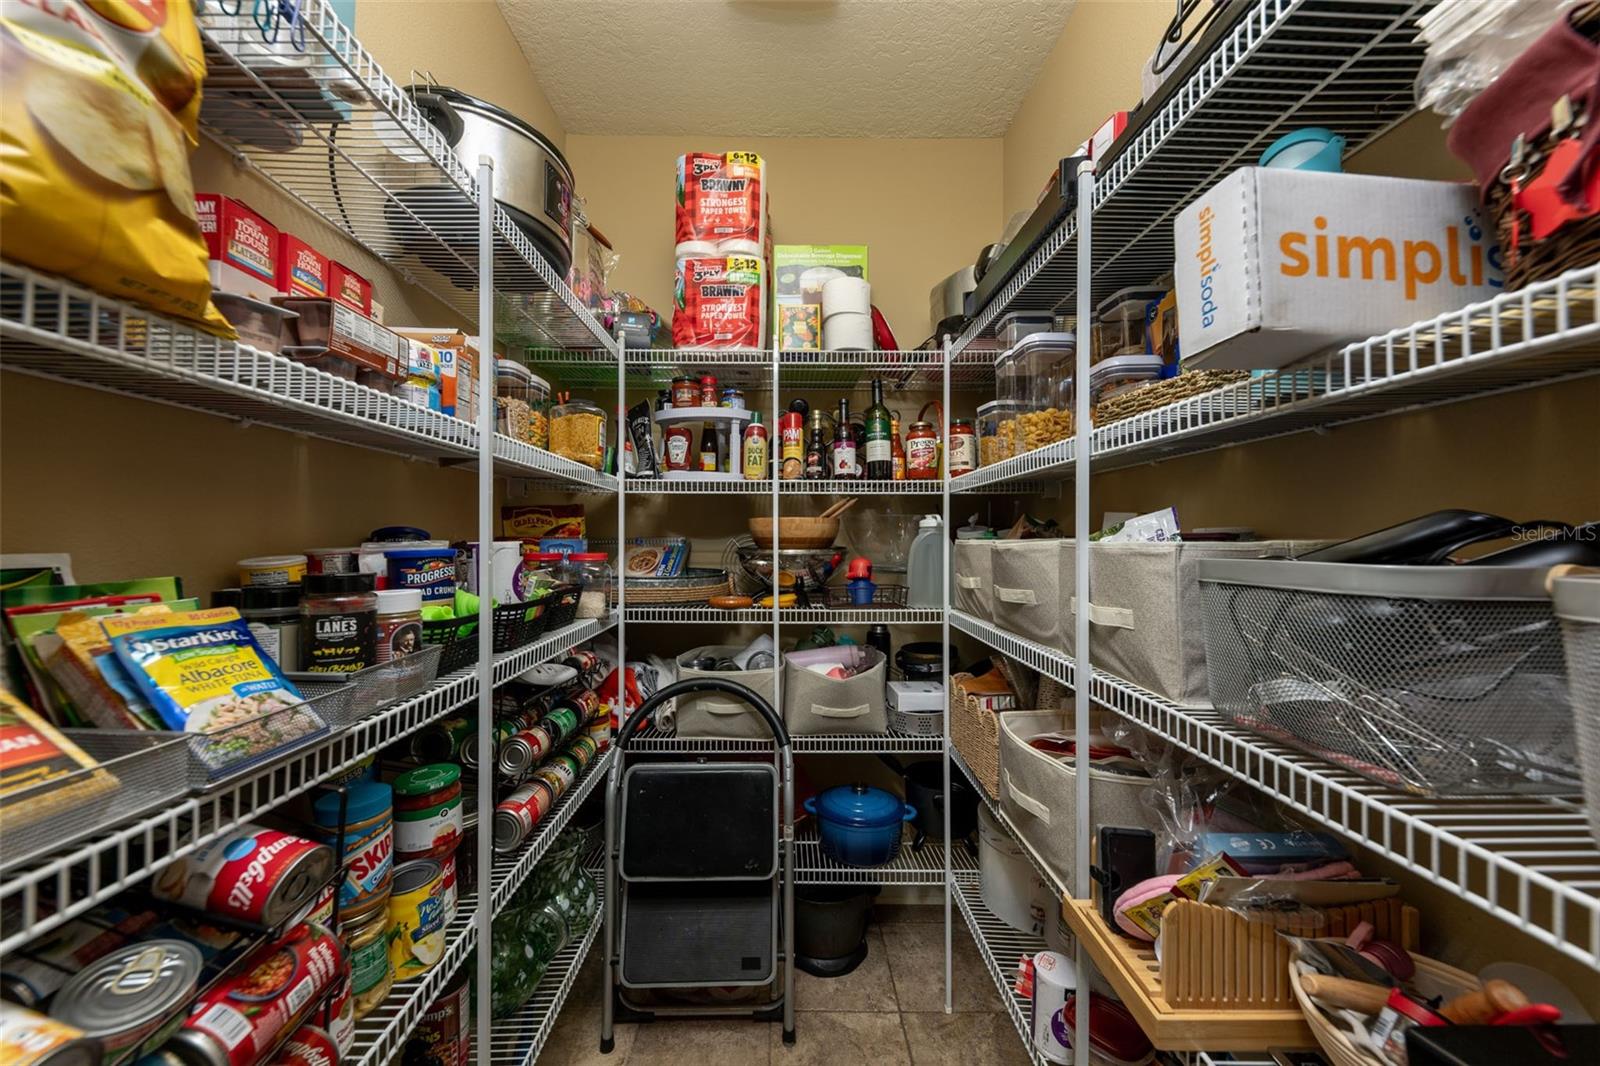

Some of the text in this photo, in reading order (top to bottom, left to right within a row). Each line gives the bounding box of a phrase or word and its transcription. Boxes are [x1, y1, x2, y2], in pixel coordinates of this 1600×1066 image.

[700, 179, 746, 192] BRAWNY
[700, 198, 746, 207] STRONGEST
[235, 218, 269, 246] TOWN
[235, 229, 270, 257] HOUSE
[297, 250, 321, 272] TOWN
[1196, 206, 1221, 328] simplisoda
[701, 285, 745, 297] BRAWNY
[701, 303, 745, 312] STRONGEST
[438, 350, 453, 363] 10
[783, 428, 800, 439] PAM
[910, 440, 935, 449] Prego
[747, 455, 763, 466] FAT
[315, 620, 358, 634] LANES
[151, 629, 238, 652] StarKist
[180, 659, 258, 685] Albacore
[185, 670, 264, 693] WHITE TUNA
